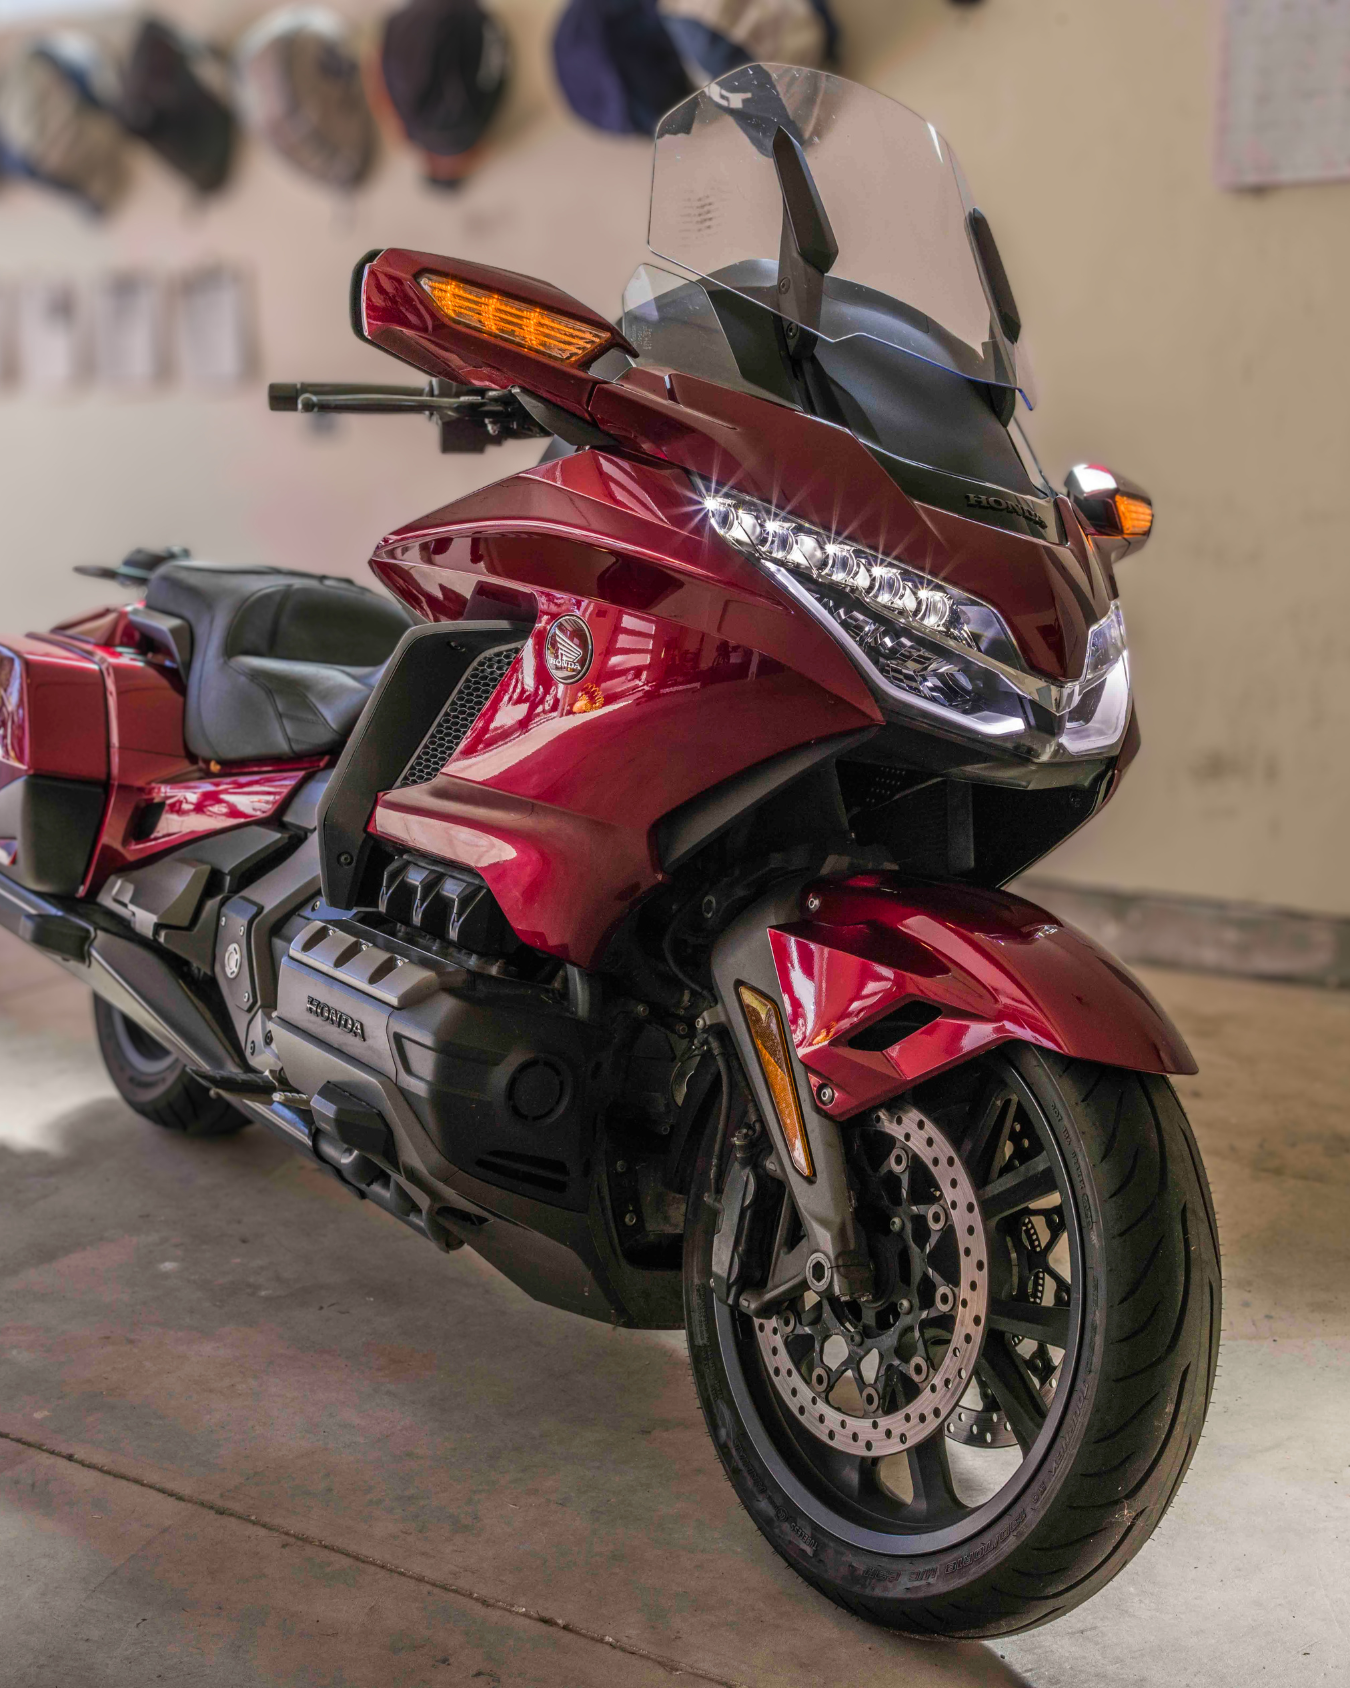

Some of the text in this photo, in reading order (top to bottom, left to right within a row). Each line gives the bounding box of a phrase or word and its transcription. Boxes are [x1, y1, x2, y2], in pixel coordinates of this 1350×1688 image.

[965, 493, 1048, 530] HONDA
[550, 658, 582, 670] HONDA
[306, 995, 366, 1042] HONDA
[788, 1521, 819, 1550] TUBELESS
